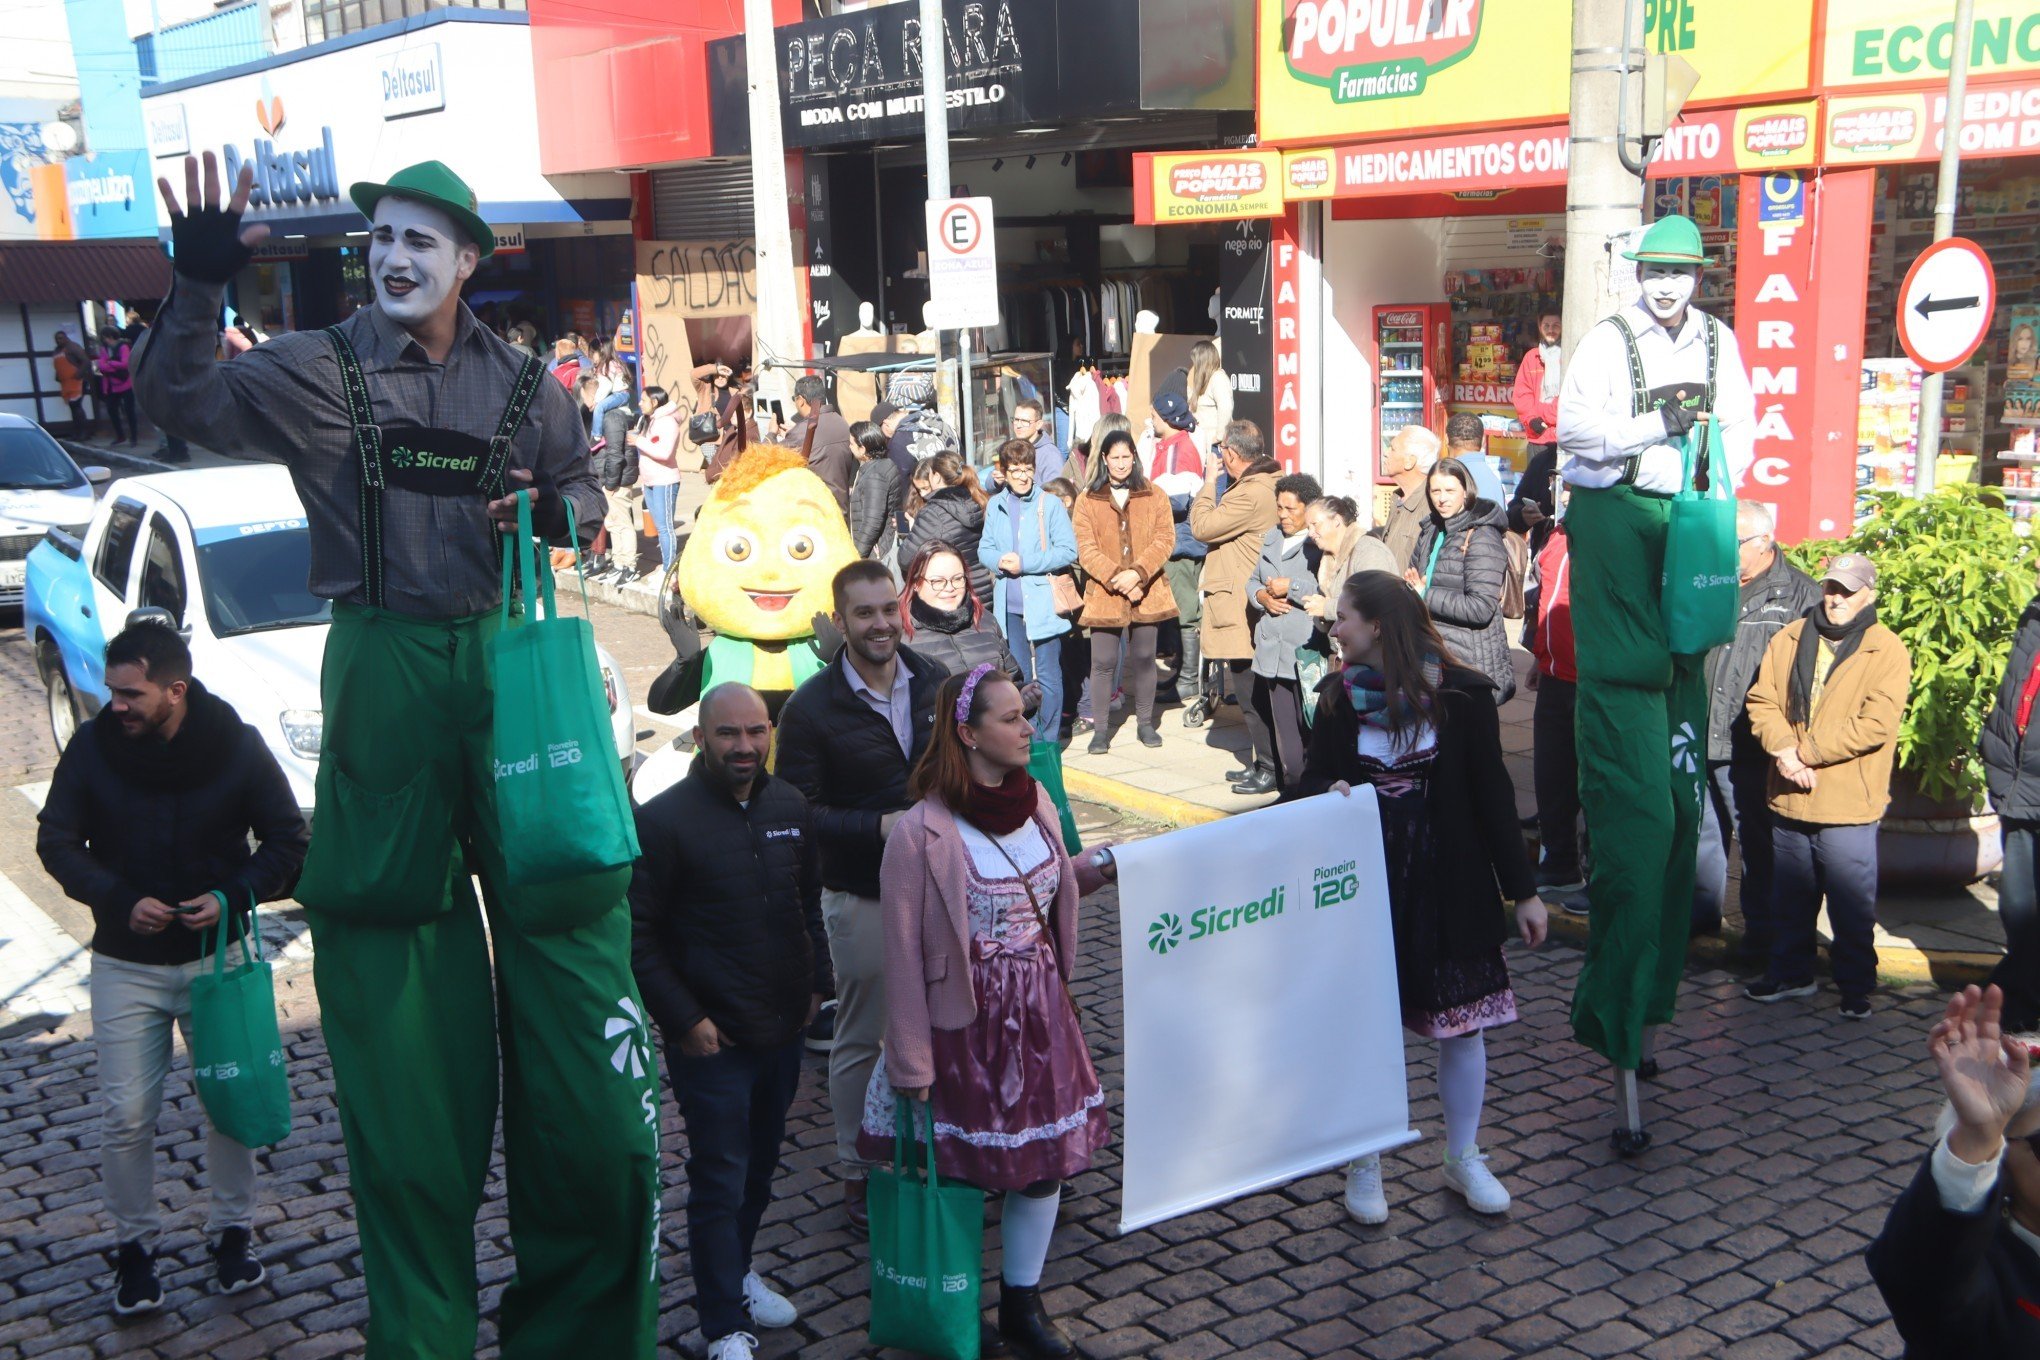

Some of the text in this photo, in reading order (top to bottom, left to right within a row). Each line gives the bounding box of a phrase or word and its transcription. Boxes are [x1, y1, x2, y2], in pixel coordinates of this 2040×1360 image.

[1292, 0, 1474, 58] POPULAR
[788, 24, 884, 95] PEÇA
[382, 59, 436, 102] Deltasul
[1338, 66, 1418, 99] Farmácias
[801, 84, 1005, 127] MODA COM MUIT ESTILO
[1764, 117, 1805, 134] MAIS
[1747, 132, 1806, 148] POPULAR
[1174, 163, 1261, 180] PREÇO MAIS
[1344, 142, 1516, 185] MEDICAMENTOS
[1518, 138, 1569, 173] COM
[1175, 177, 1263, 194] POPULAR
[1291, 170, 1328, 183] POPULAR
[1168, 202, 1269, 217] ECONOMIA SEMPRE
[952, 215, 969, 243] E
[810, 264, 831, 277] AERO
[1225, 306, 1264, 320] FORMITZ
[415, 451, 479, 472] Sicredi
[239, 519, 301, 536] DEPTO
[1188, 885, 1285, 941] Sicredi
[886, 1267, 927, 1290] Sicredi
